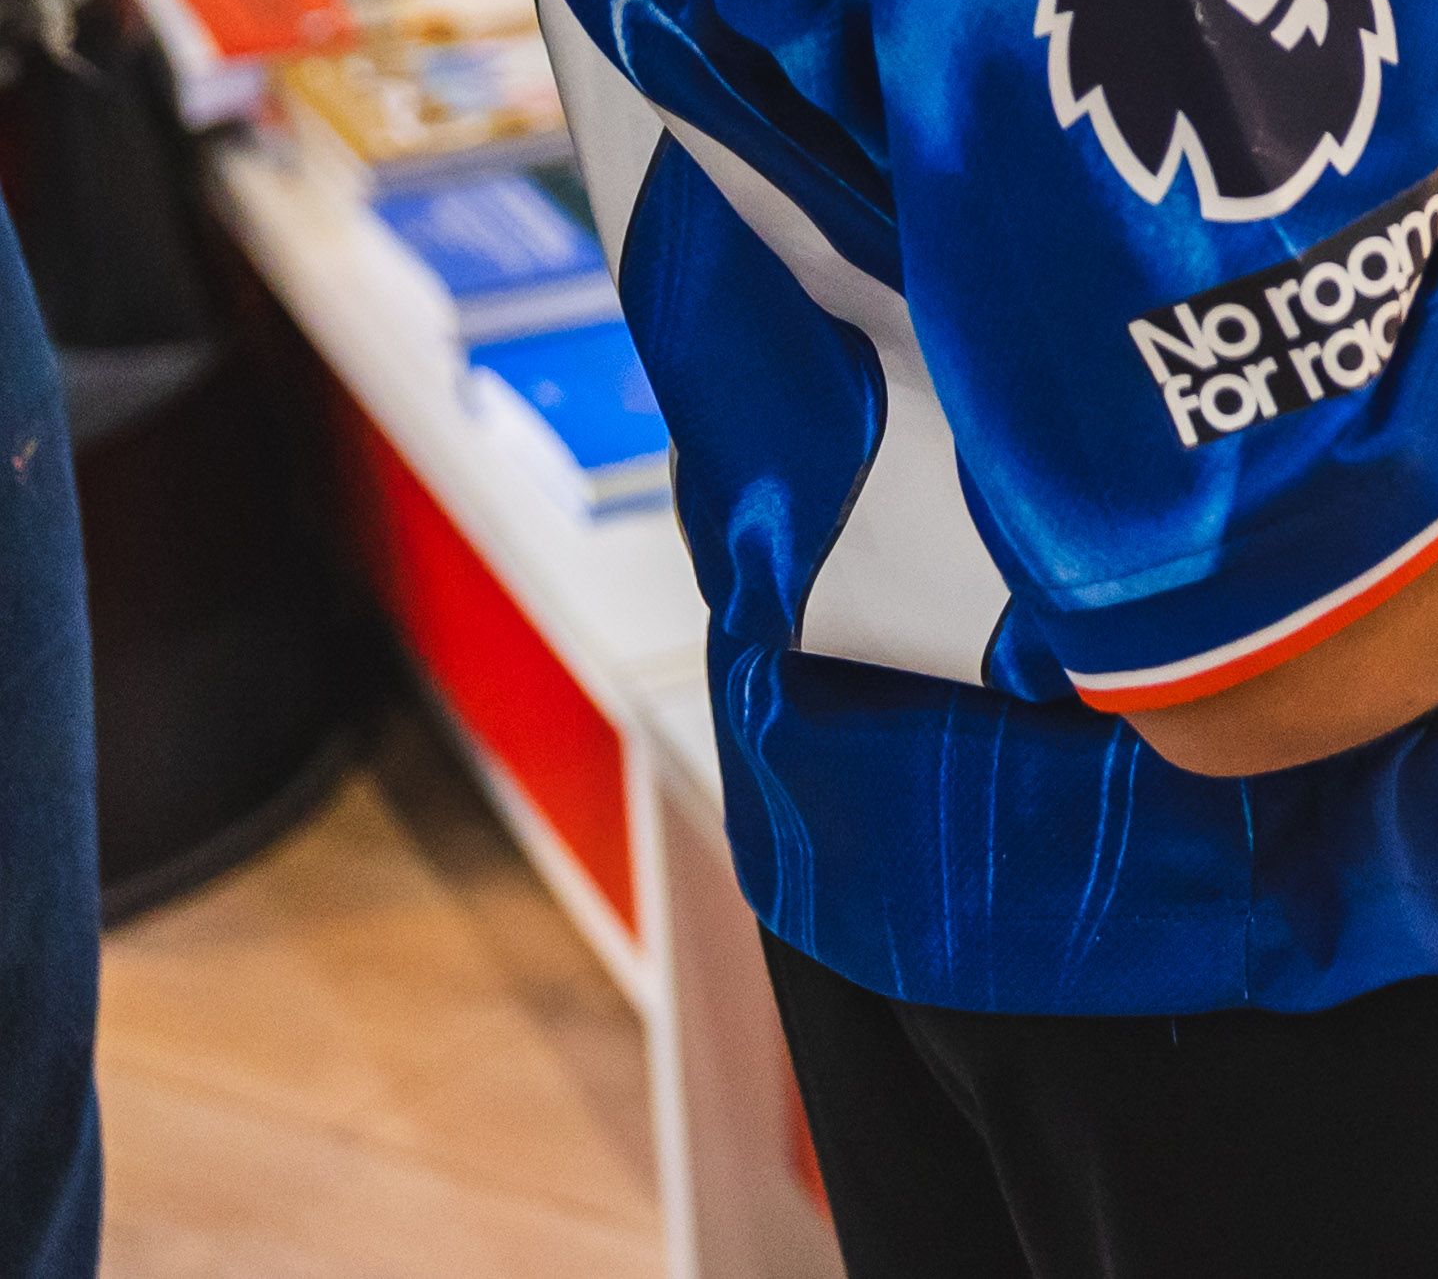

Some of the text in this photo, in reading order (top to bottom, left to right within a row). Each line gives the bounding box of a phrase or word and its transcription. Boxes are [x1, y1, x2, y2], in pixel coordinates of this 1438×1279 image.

[1128, 302, 1260, 387] No
[1163, 283, 1422, 449] for rac
